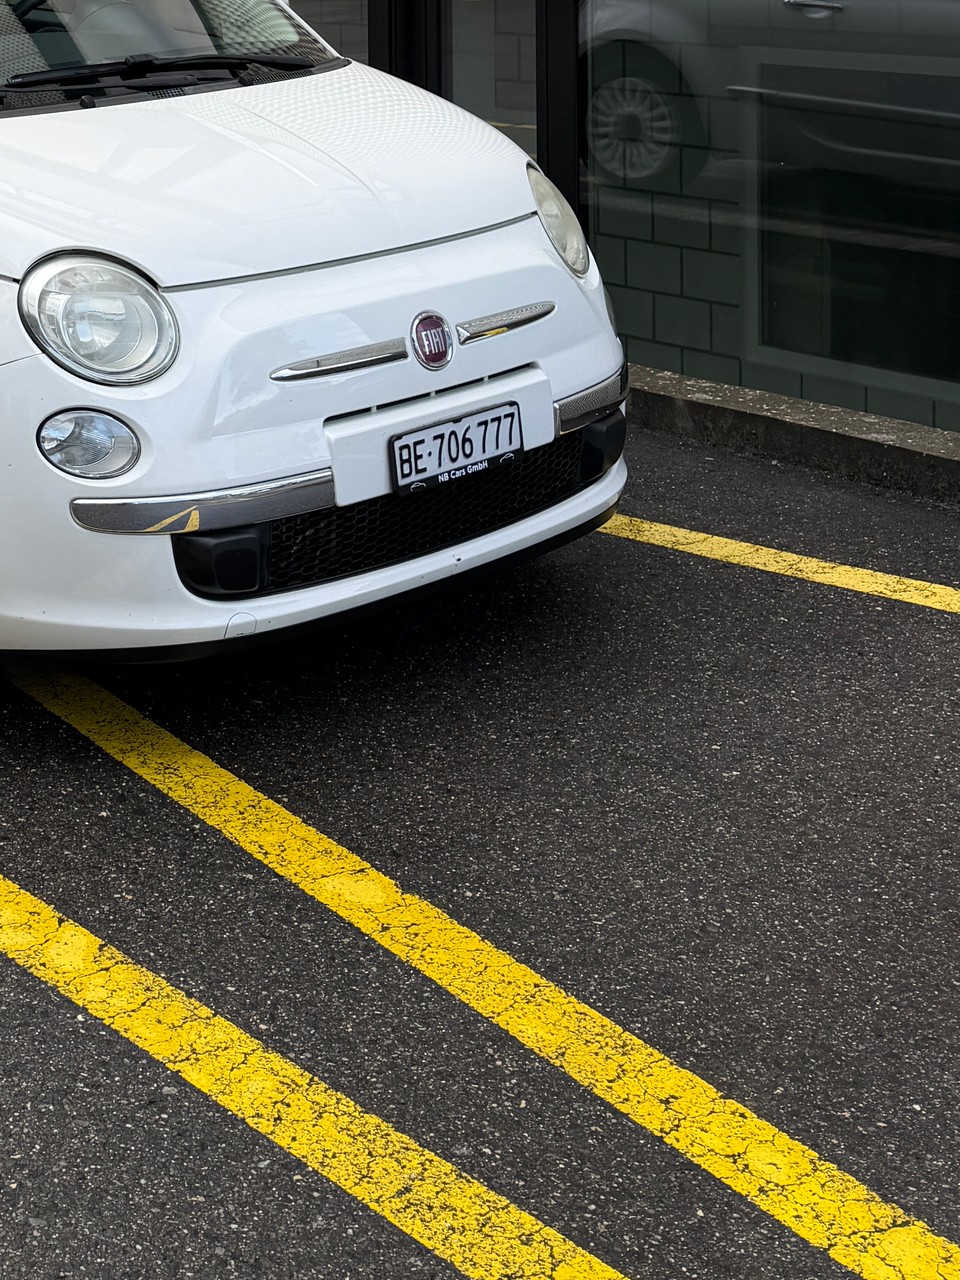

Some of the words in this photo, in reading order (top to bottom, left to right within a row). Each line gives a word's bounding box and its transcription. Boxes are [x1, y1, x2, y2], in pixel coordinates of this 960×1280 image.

[421, 327, 446, 355] FIAT
[438, 472, 450, 484] NB
[450, 467, 466, 479] Cars
[466, 460, 489, 474] GmbH
